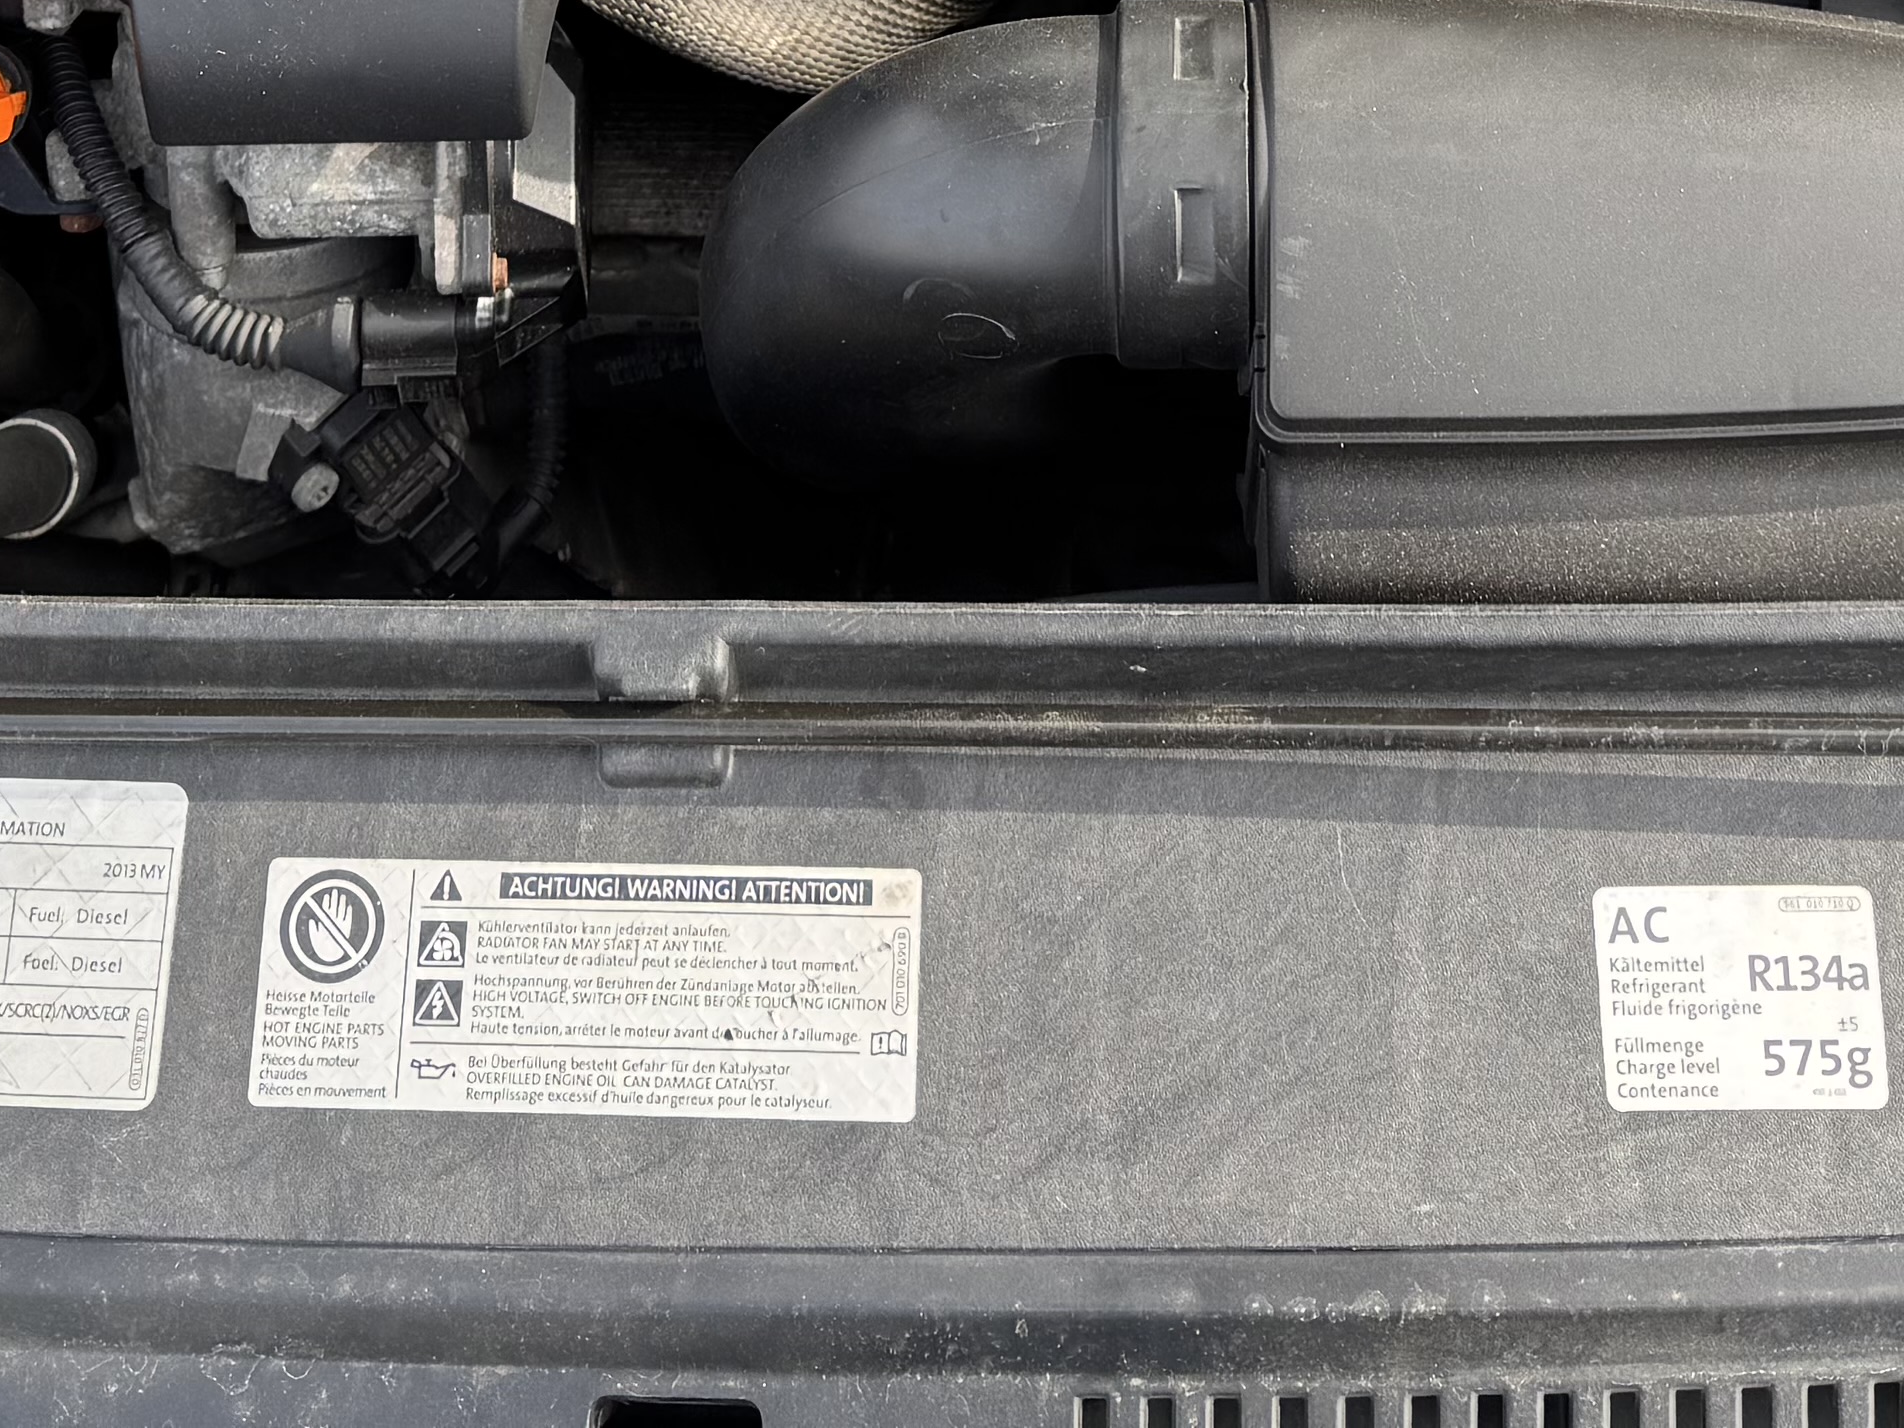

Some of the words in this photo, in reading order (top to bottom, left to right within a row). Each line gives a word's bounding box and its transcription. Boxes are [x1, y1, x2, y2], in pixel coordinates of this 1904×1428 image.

[102, 862, 137, 878] 2013
[139, 863, 165, 879] MY
[508, 875, 619, 899] ACHTUNG!
[625, 877, 737, 901] WARNING!
[741, 880, 864, 904] ATTENTION!
[27, 906, 65, 923] Fuel:
[75, 908, 128, 925] Diesel
[1608, 906, 1669, 943] AC
[476, 935, 539, 949] RADIATOR
[542, 936, 567, 950] FAN
[571, 937, 600, 950] MAY
[603, 938, 639, 951] START
[643, 938, 658, 951] AT
[662, 939, 688, 952] ANY
[692, 939, 726, 953] TIME.
[22, 954, 59, 970] Fuel:
[70, 955, 122, 972] Diesel
[1609, 955, 1705, 973] Kältemittel
[1748, 954, 1870, 991] R134a
[1611, 978, 1707, 999] Refrigerant
[472, 989, 506, 1002] HIGH
[508, 990, 569, 1006] VOLTAGE,
[571, 991, 621, 1005] SWITCH
[624, 992, 647, 1006] OFF
[651, 993, 699, 1007] ENGINE
[703, 994, 751, 1008] BEFORE
[827, 997, 886, 1011] IGNITION
[1612, 1000, 1663, 1017] Fluide
[1668, 998, 1763, 1020] frigorigène
[470, 1004, 525, 1019] SYSTEM.
[262, 1020, 290, 1033] HOT
[294, 1021, 342, 1034] ENGINE
[346, 1022, 385, 1035] PARTS
[1837, 1016, 1859, 1032] ±5
[261, 1034, 317, 1048] MOVING
[321, 1036, 359, 1049] PARTS
[1615, 1036, 1705, 1057] Füllmenge
[1616, 1059, 1676, 1080] Charge
[1681, 1057, 1720, 1074] level
[1763, 1039, 1874, 1089] 575g
[466, 1071, 541, 1085] OVERFILLED
[544, 1072, 592, 1086] ENGINE
[595, 1074, 616, 1087] OIL
[622, 1074, 650, 1088] CAN
[654, 1075, 712, 1089] DAMAGE
[1617, 1082, 1720, 1099] Contenance
